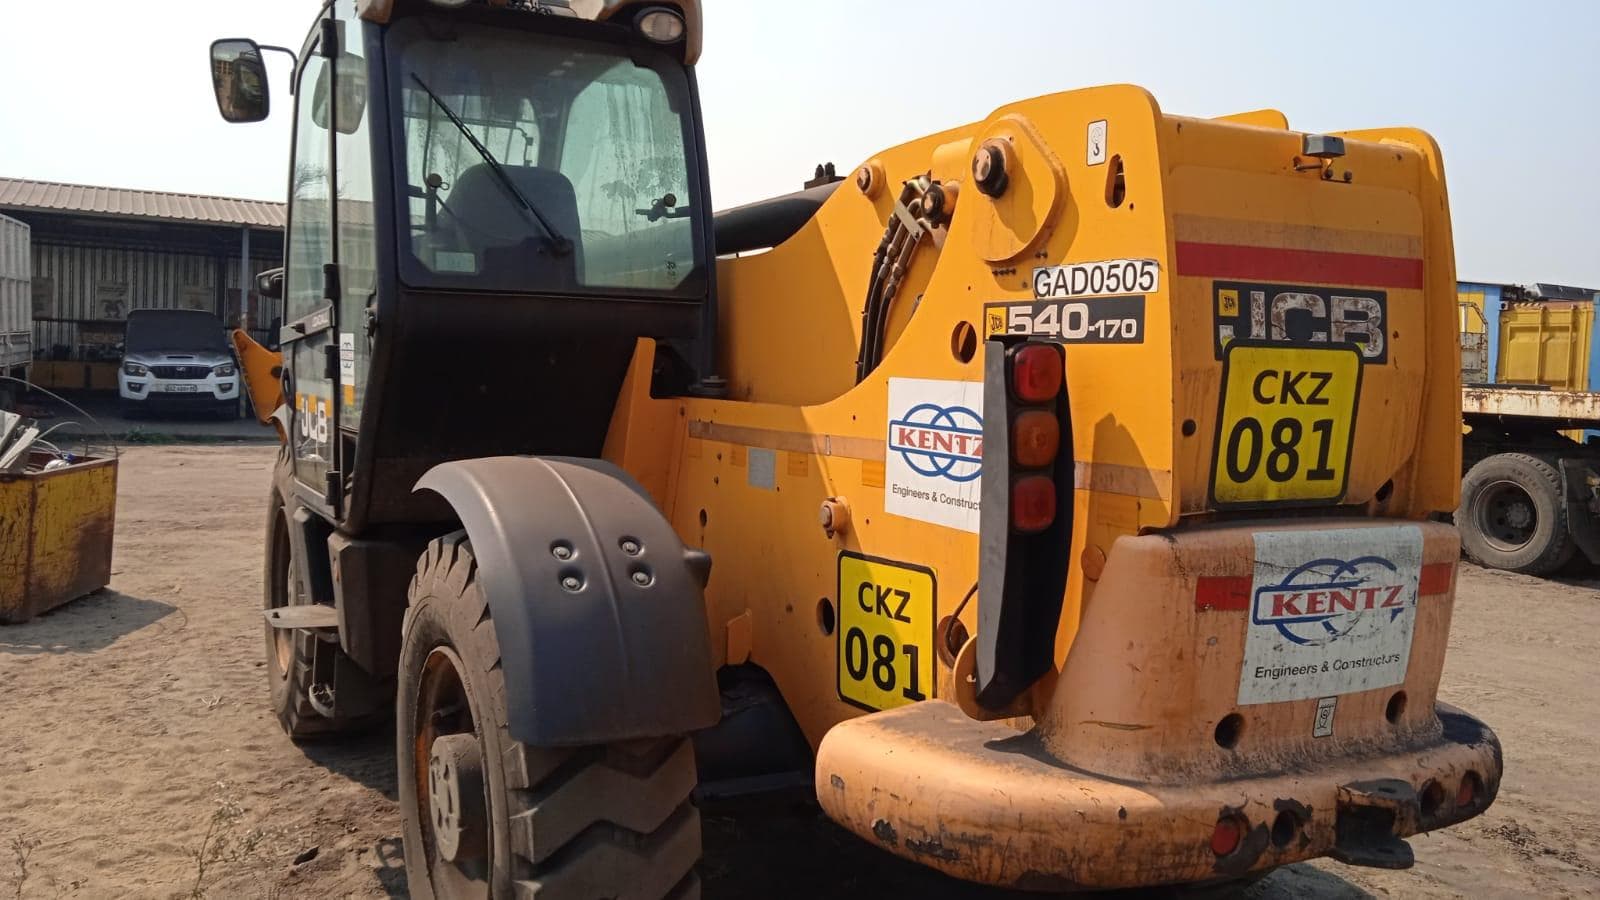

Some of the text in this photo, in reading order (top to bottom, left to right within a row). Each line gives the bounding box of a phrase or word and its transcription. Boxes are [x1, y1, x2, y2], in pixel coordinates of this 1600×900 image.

[1034, 262, 1155, 298] GAD0505
[1219, 290, 1384, 358] JCB
[1252, 369, 1333, 405] CKZ
[1226, 416, 1336, 484] 081
[892, 483, 930, 501] Engineers
[931, 492, 938, 503] &
[858, 581, 911, 624] CKZ
[1271, 585, 1404, 617] KENTZ
[845, 626, 926, 701] 081
[1254, 665, 1318, 680] Engineers
[1320, 660, 1329, 672] &
